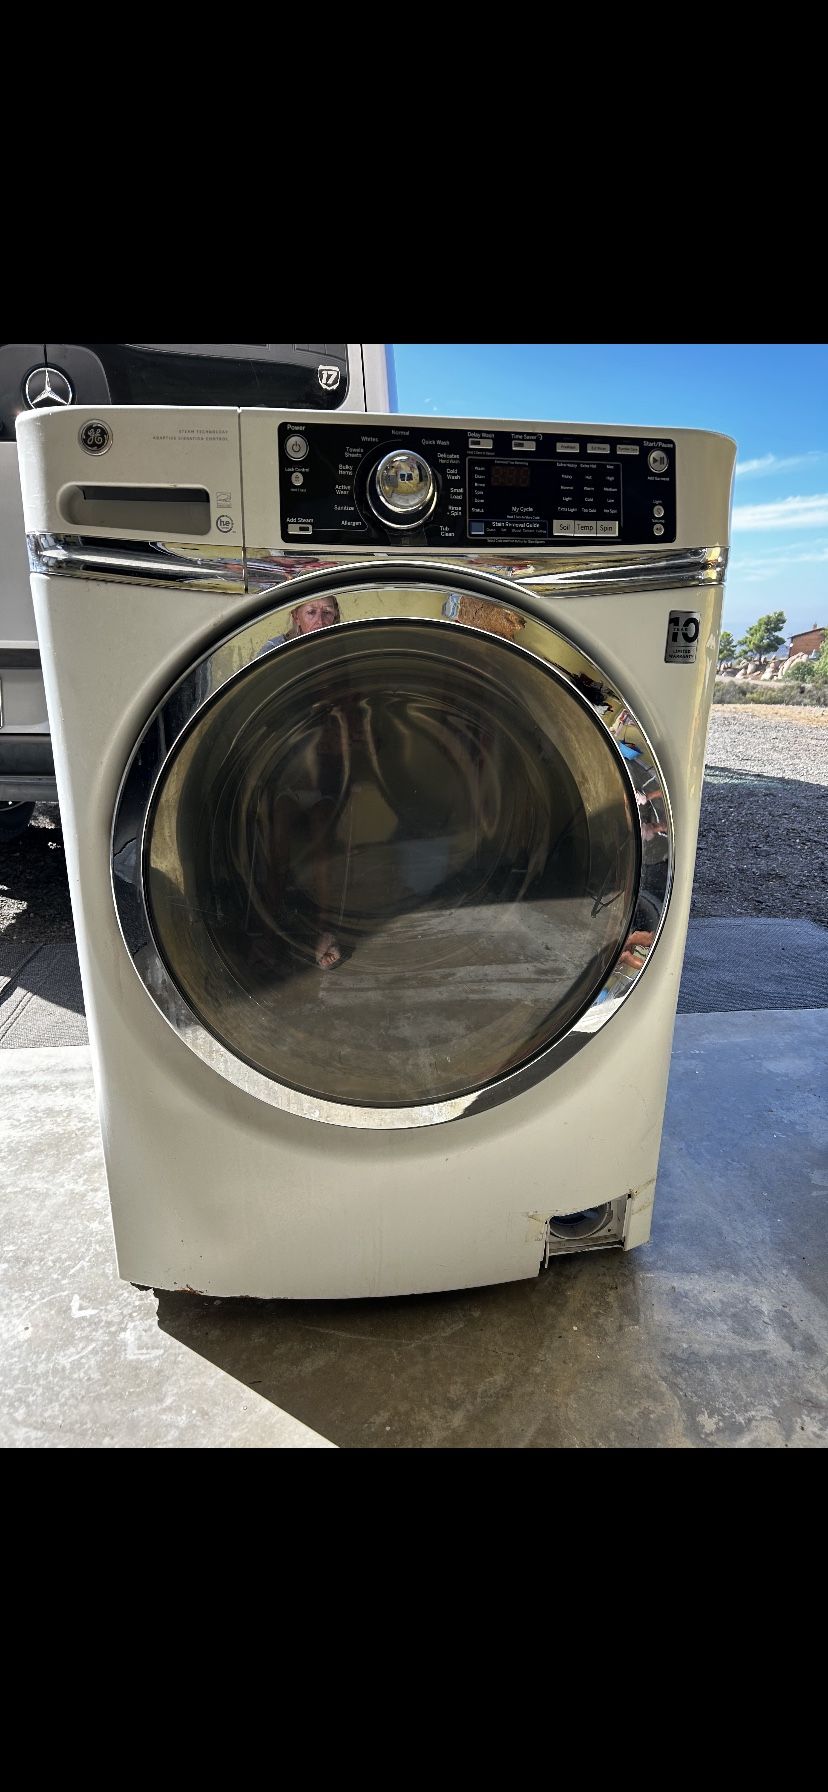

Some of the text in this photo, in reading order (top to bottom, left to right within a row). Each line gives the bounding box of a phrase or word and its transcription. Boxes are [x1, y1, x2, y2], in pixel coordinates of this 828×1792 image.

[321, 370, 337, 384] 17
[600, 524, 612, 532] Spin
[669, 616, 700, 643] 10
